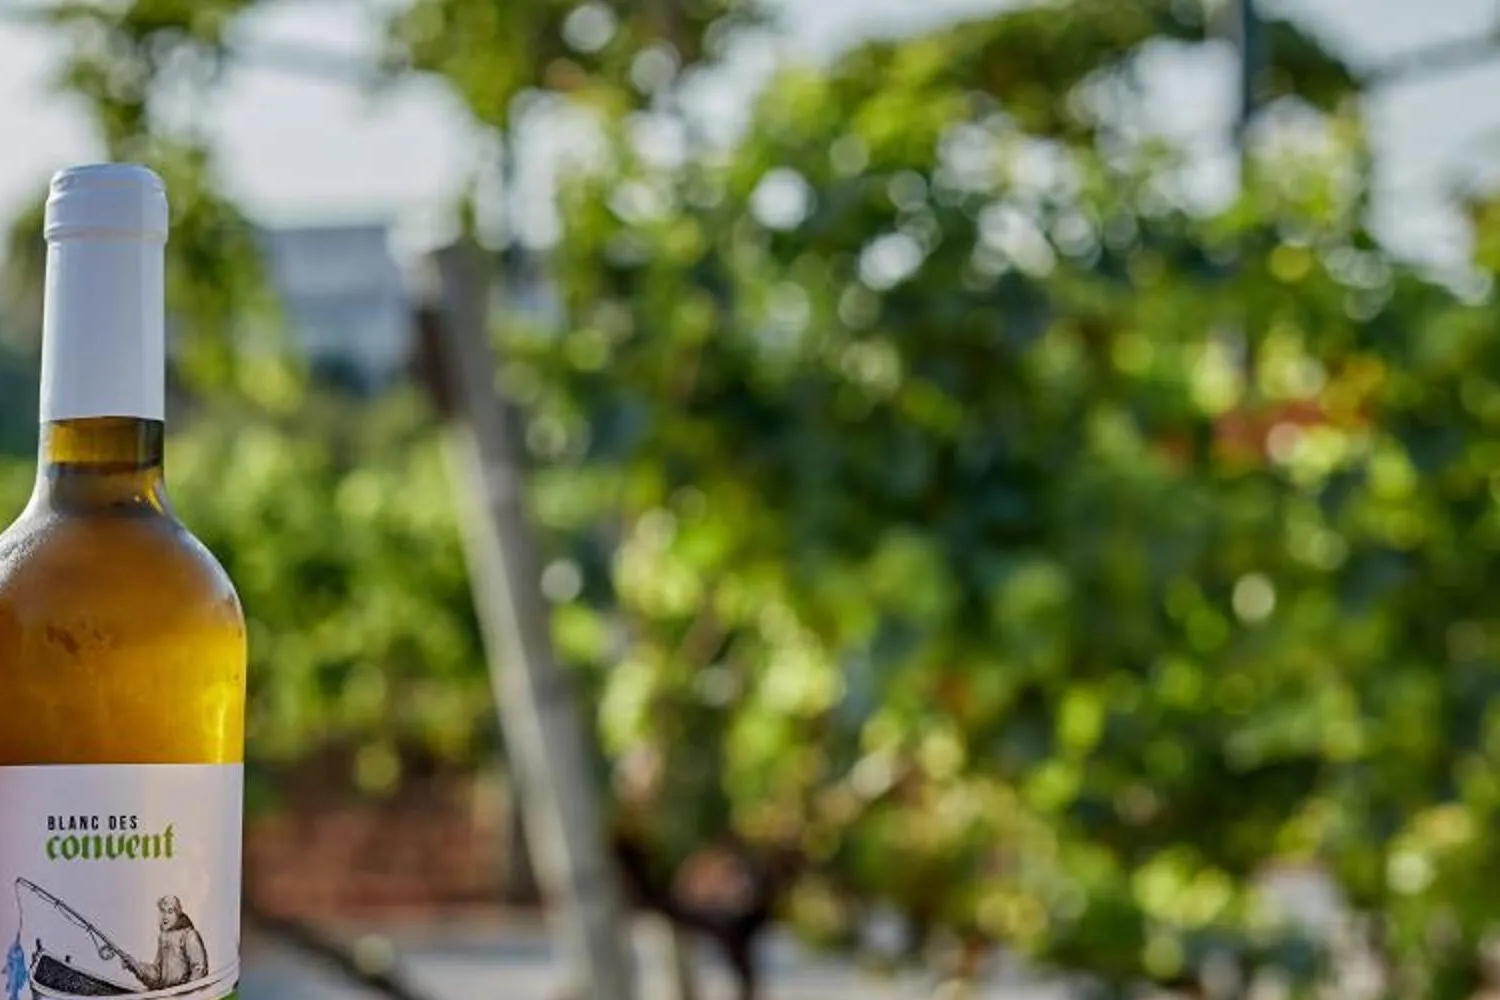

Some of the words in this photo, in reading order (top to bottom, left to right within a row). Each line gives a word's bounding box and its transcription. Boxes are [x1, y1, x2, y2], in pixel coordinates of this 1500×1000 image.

[47, 815, 99, 831] BLANC
[108, 815, 138, 830] DES
[46, 823, 173, 861] convent
